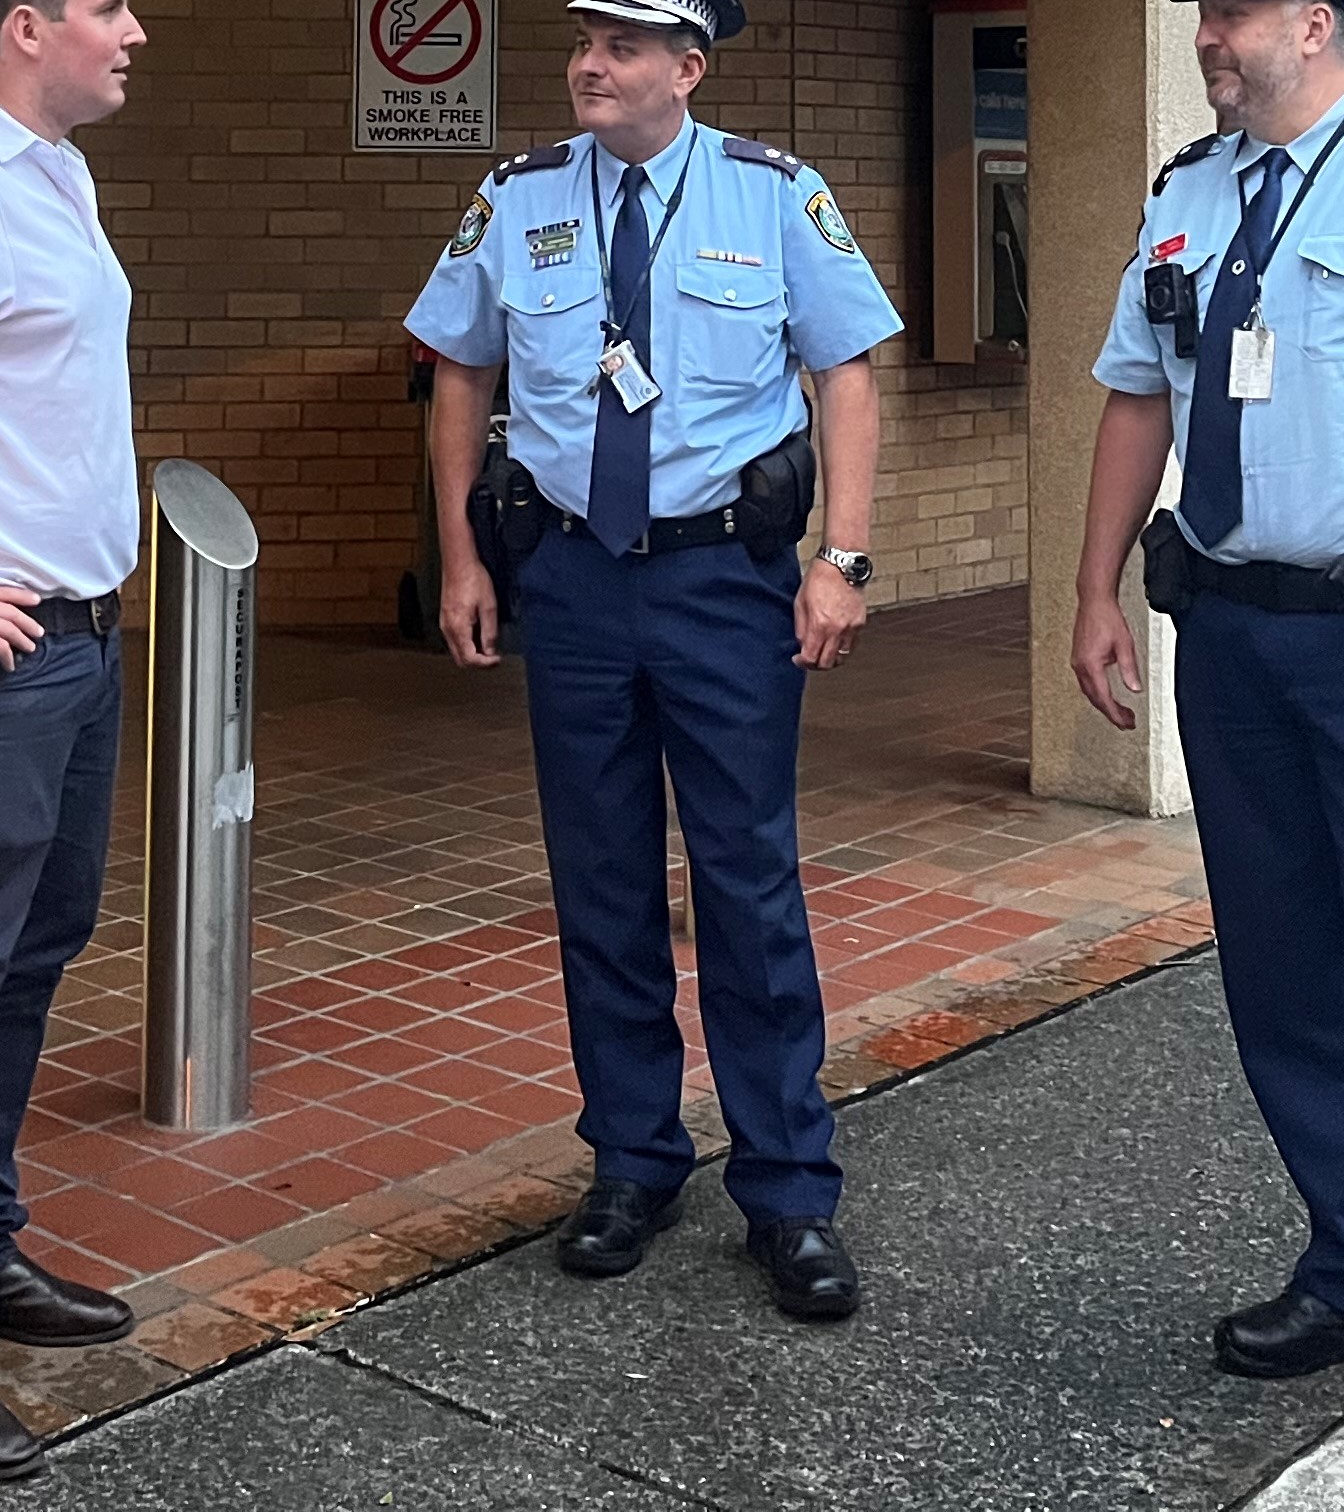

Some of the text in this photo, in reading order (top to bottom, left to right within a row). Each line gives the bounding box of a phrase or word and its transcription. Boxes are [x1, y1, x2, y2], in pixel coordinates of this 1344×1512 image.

[382, 90, 468, 105] THIS IS A
[366, 108, 484, 124] SMOKE FREE
[368, 127, 481, 142] WORKPLACE
